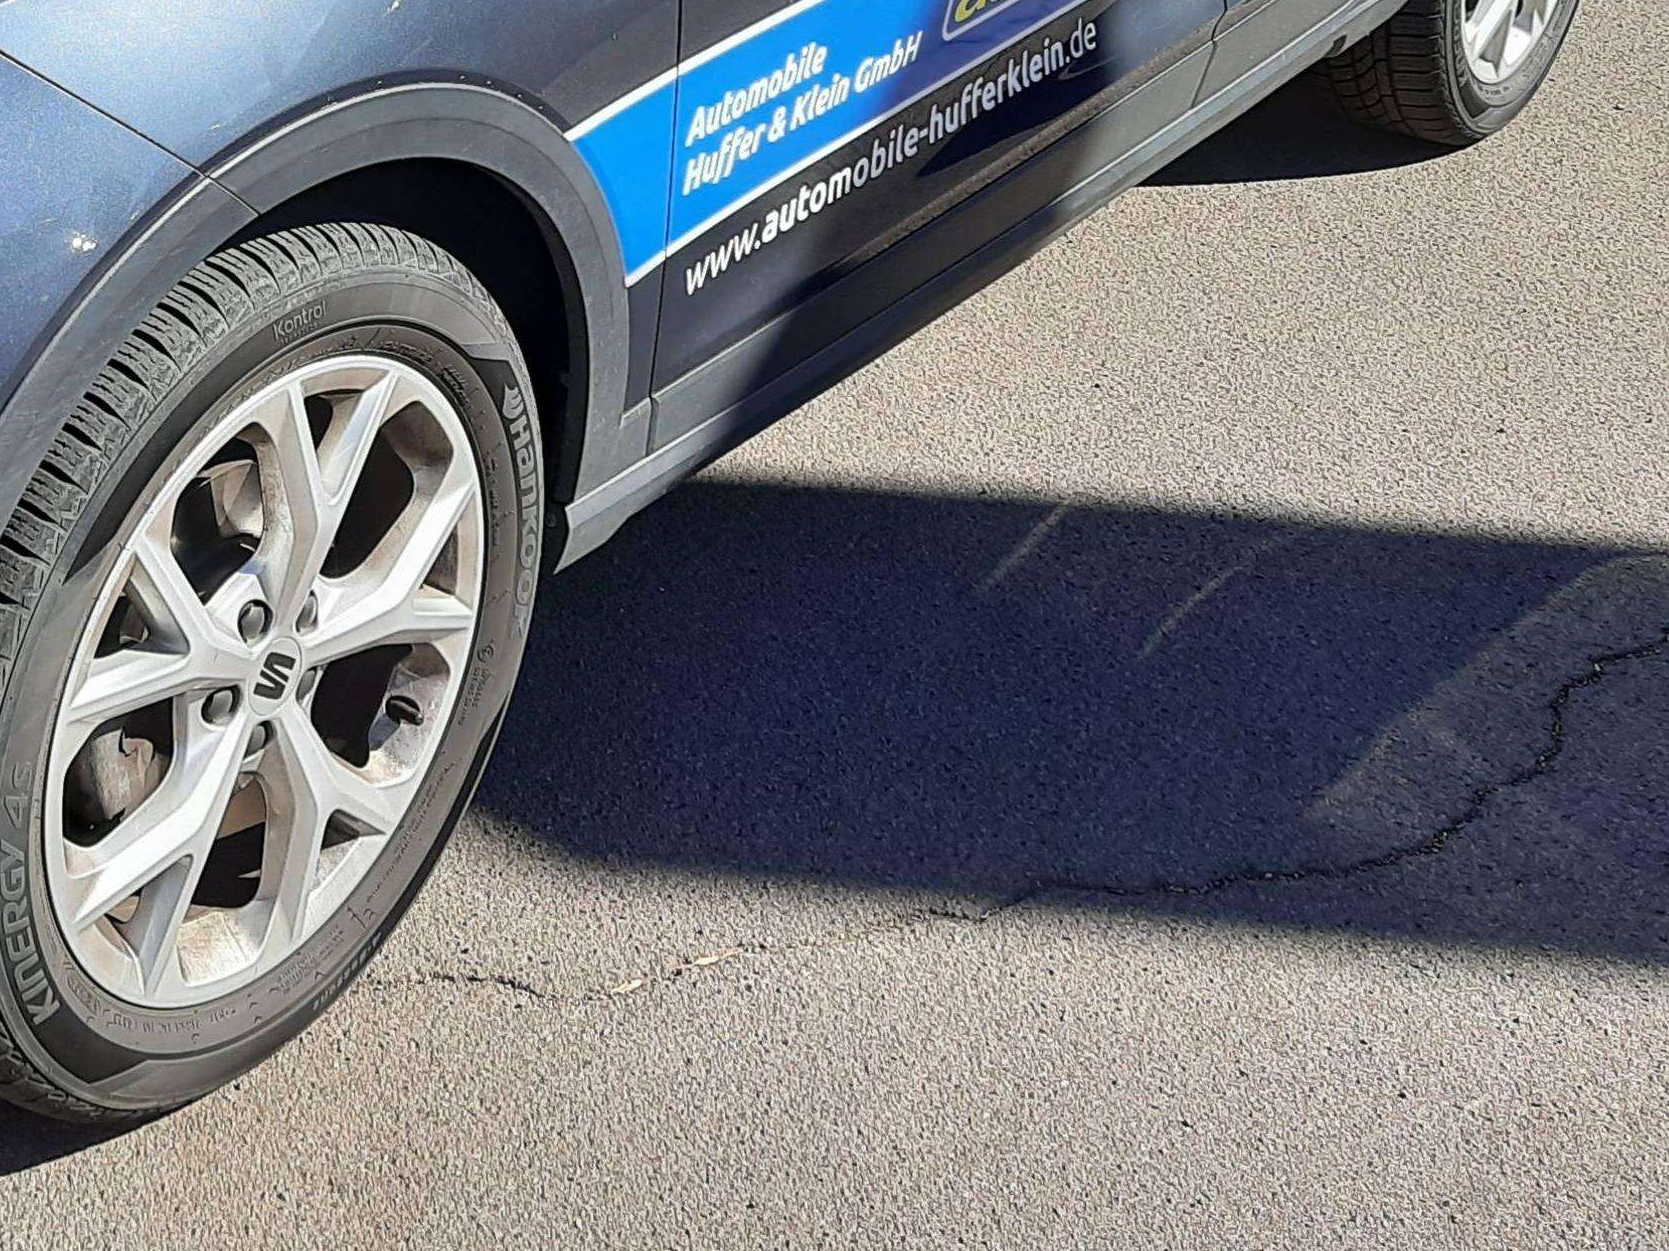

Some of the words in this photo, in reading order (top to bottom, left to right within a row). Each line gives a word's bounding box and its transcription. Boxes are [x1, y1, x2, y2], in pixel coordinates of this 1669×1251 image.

[682, 122, 767, 197] Huffer
[767, 105, 788, 144] &
[789, 73, 851, 132] Klein
[853, 30, 924, 94] GmbH
[683, 17, 1098, 297] www.automobile-hufferklein.de
[684, 41, 828, 148] Automobile
[273, 300, 327, 341] Kontrol
[507, 417, 542, 639] Hankook
[0, 838, 61, 1027] KINERGY
